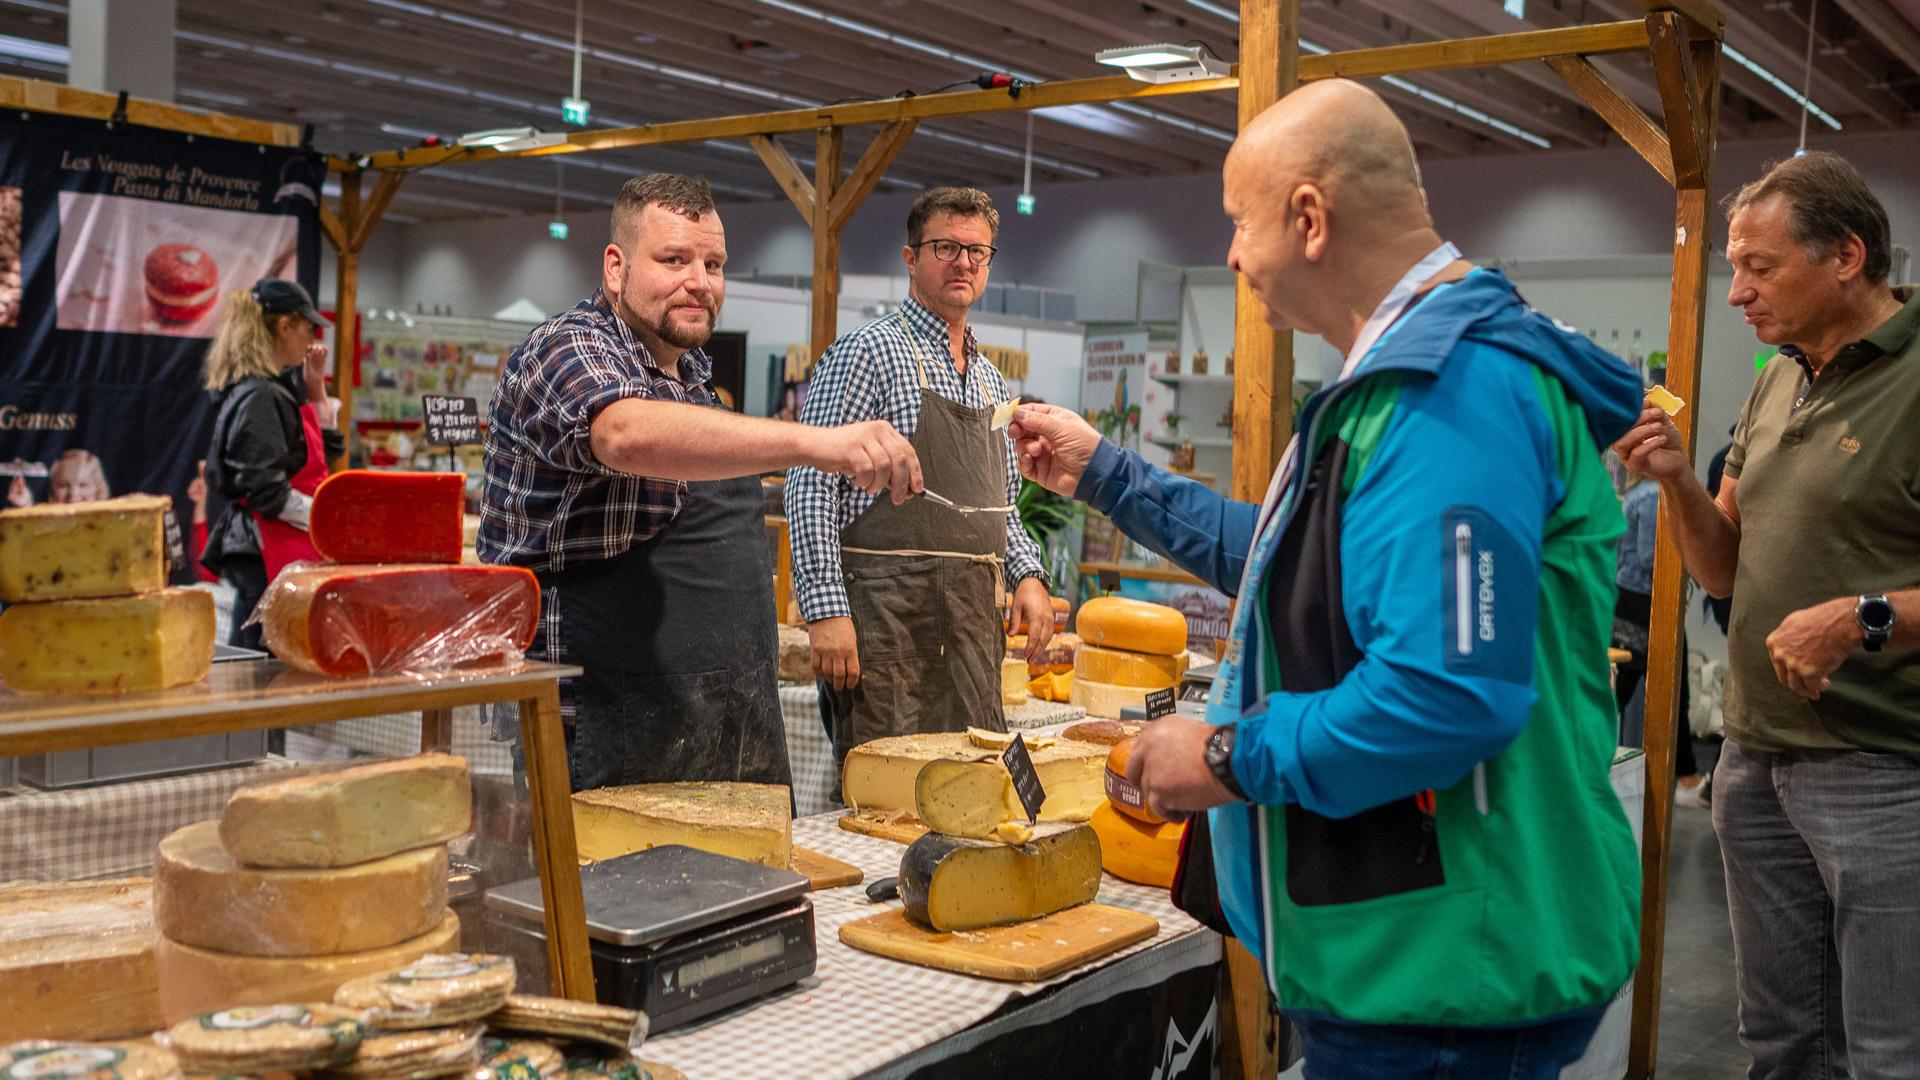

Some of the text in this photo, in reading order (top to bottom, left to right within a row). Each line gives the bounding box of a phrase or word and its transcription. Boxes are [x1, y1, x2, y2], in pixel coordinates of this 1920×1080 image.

[60, 150, 261, 192] Les Nougats de Provence
[112, 175, 260, 211] Pasta di Mandorla
[0, 405, 78, 431] Genuss
[1479, 551, 1495, 641] ORTOVOX
